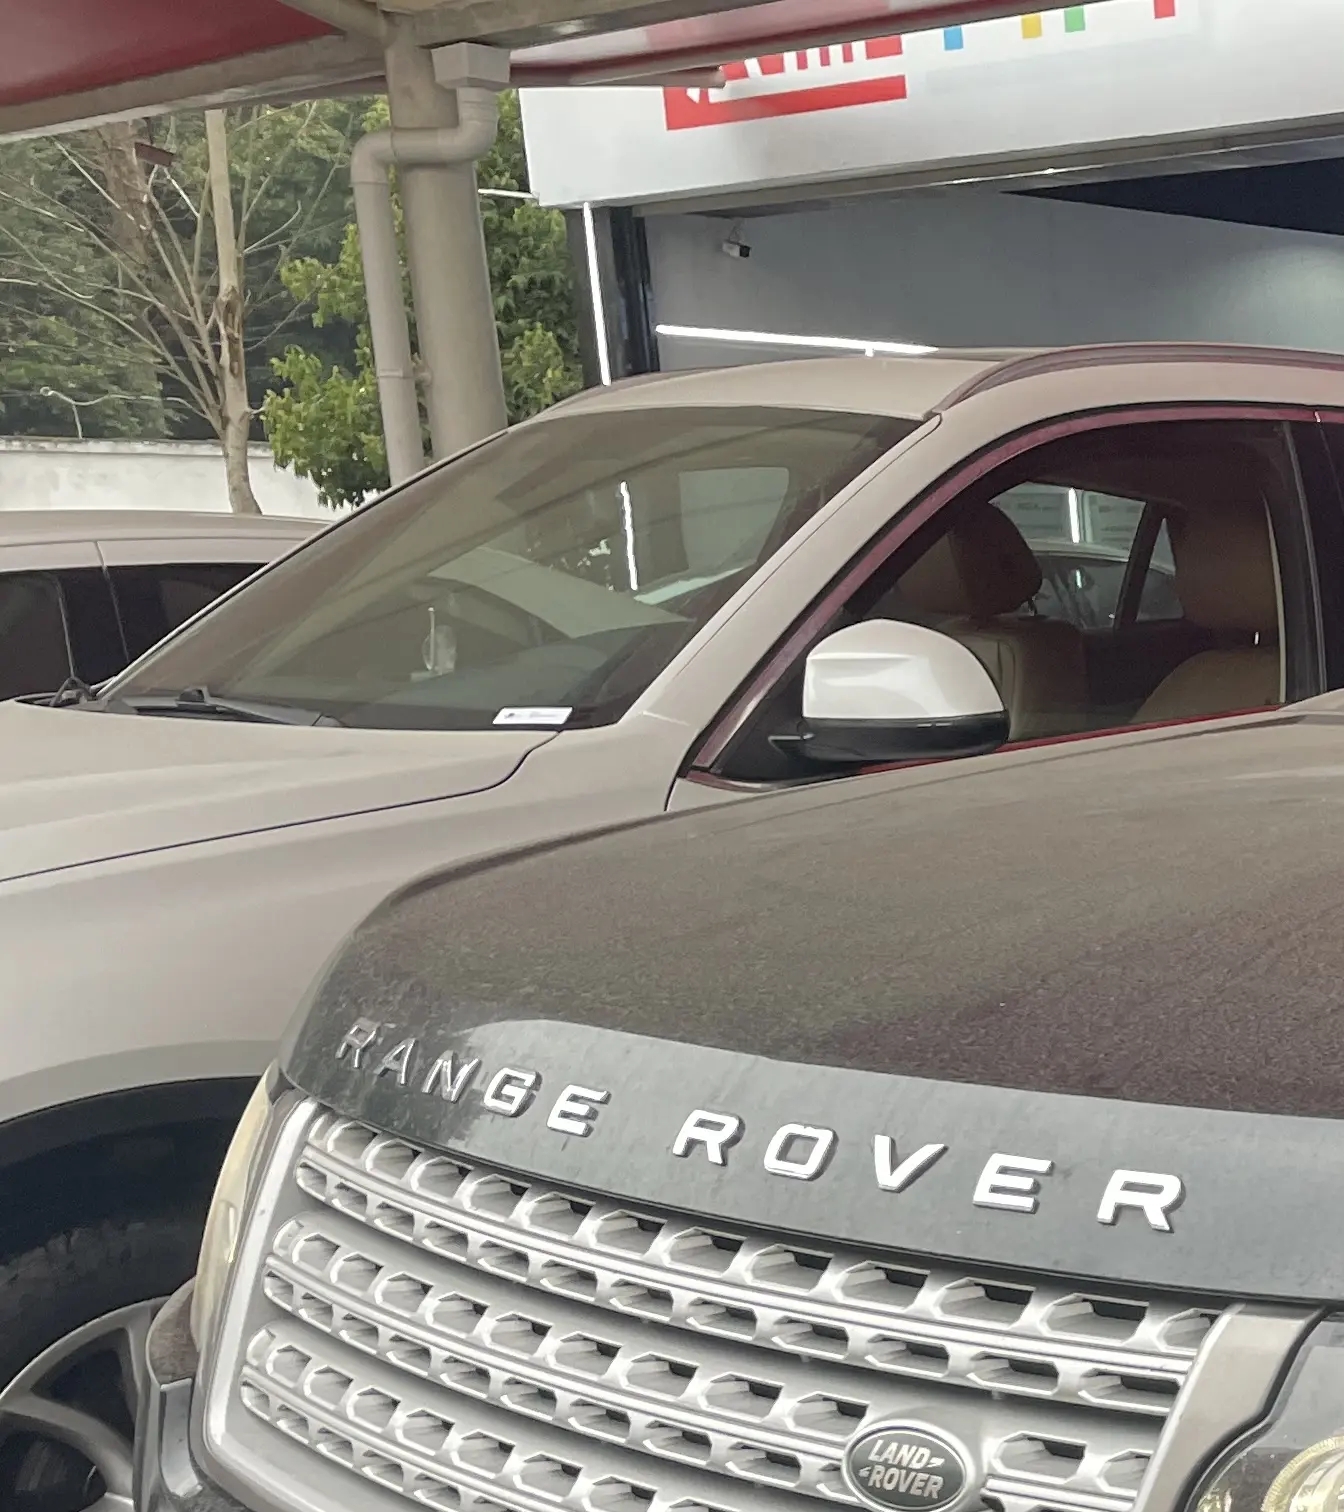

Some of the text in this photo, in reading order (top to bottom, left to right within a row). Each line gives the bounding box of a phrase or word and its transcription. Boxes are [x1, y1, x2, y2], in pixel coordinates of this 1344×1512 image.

[335, 1017, 1186, 1233] RANGE ROVER
[867, 1440, 931, 1469] LAND
[867, 1465, 945, 1499] ROVER
